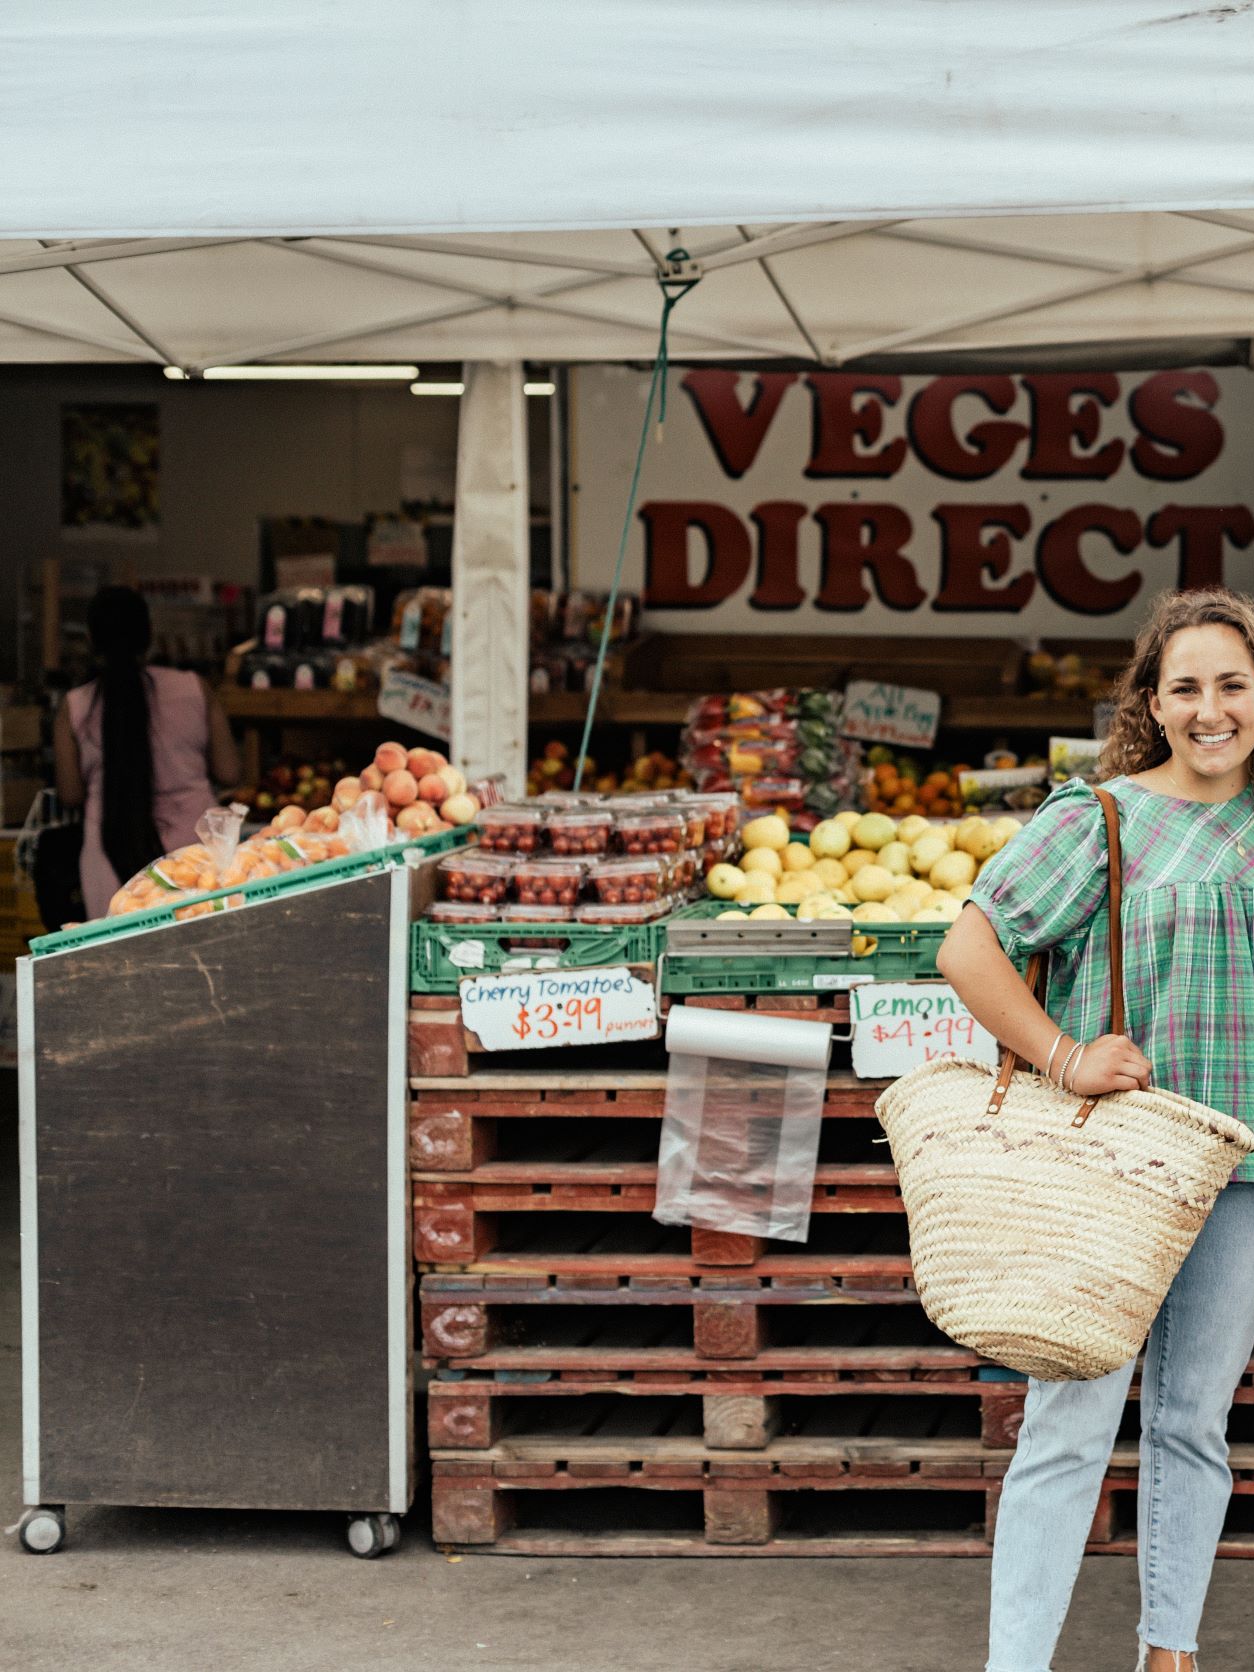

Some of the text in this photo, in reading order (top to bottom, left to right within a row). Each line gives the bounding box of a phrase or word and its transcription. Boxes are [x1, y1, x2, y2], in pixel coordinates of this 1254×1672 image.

[680, 369, 1225, 481] VEGES
[466, 976, 633, 1004] Cherry Tomatoes
[873, 1017, 974, 1046] $4.99
